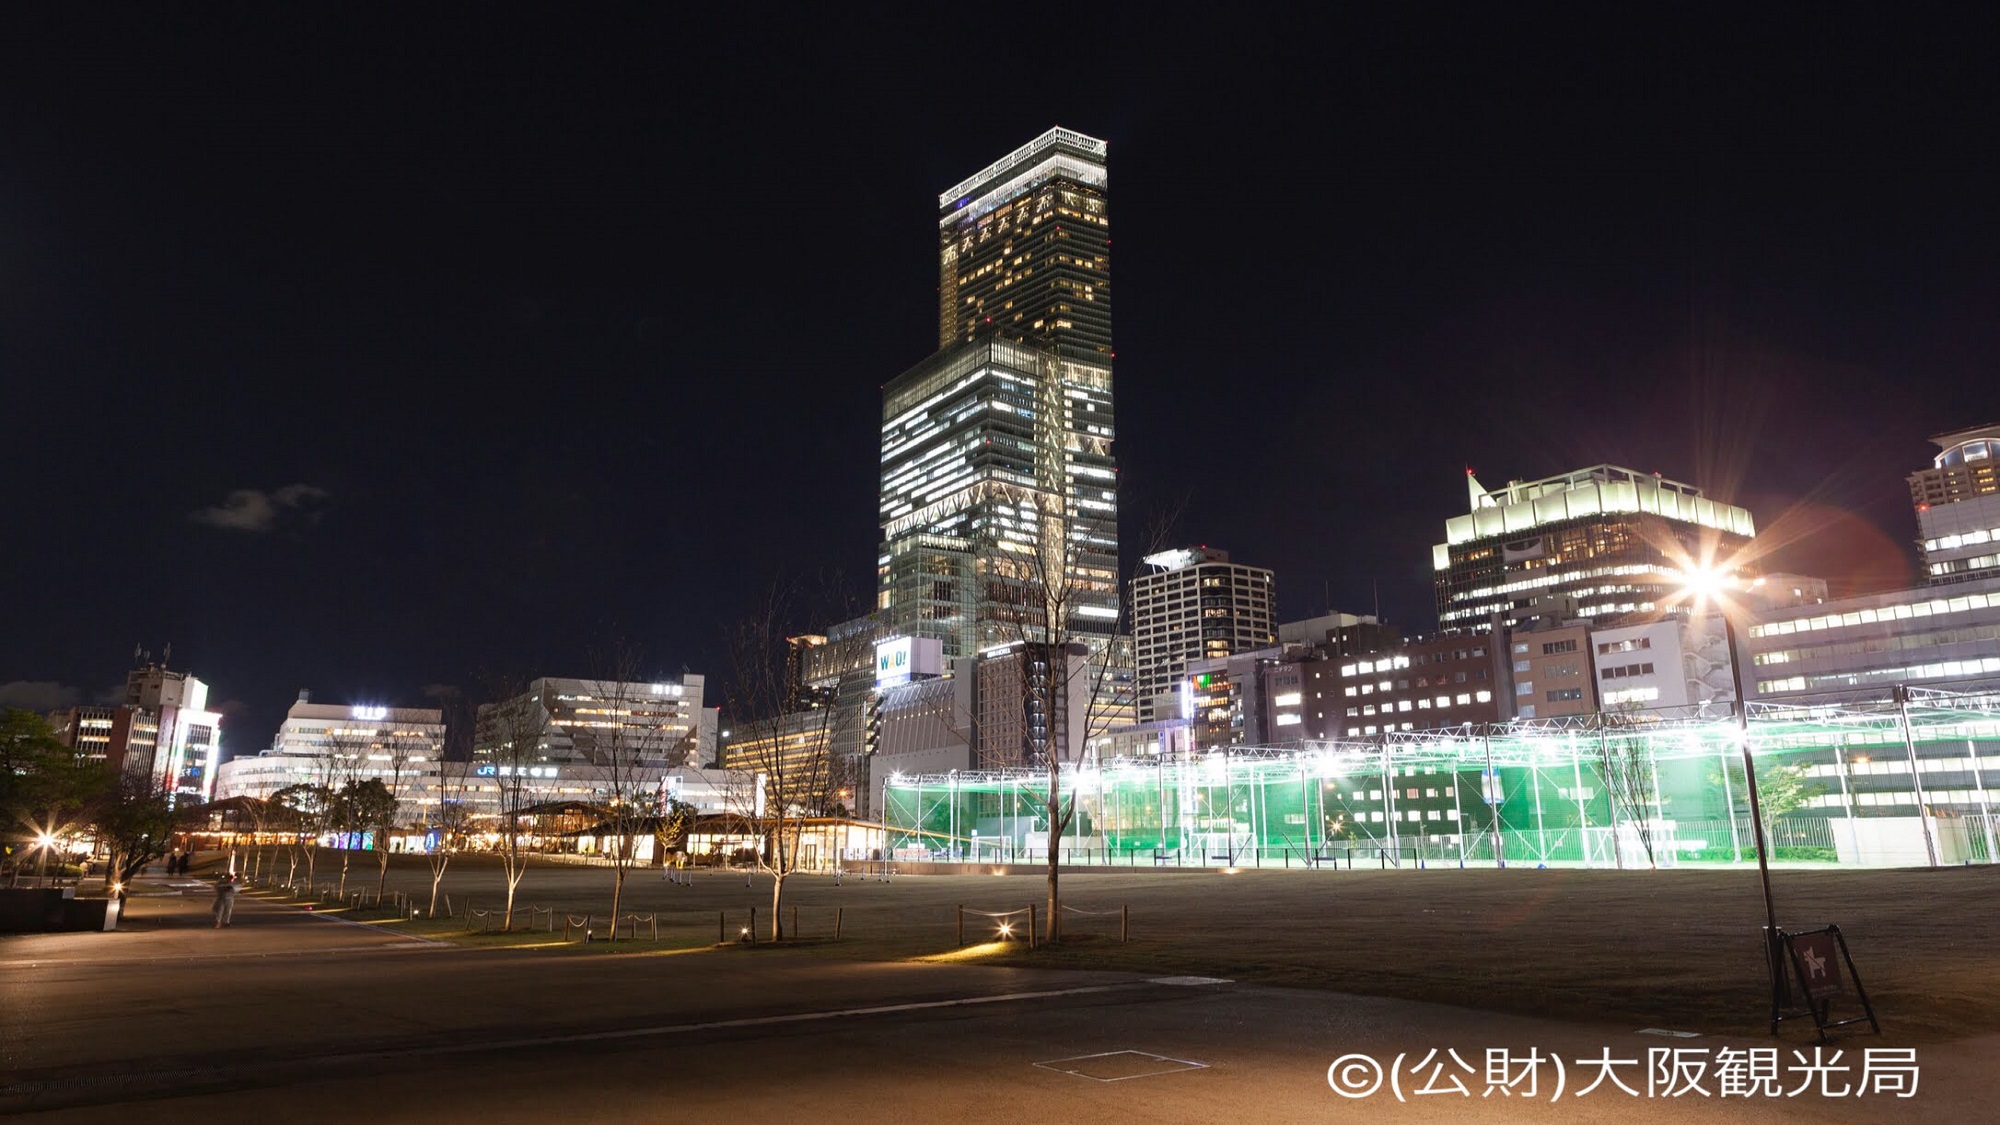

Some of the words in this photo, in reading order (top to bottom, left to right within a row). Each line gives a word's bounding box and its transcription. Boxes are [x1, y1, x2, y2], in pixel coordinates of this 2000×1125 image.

[880, 650, 907, 671] WAO!
[652, 684, 683, 696] MIO
[476, 766, 495, 776] JR
